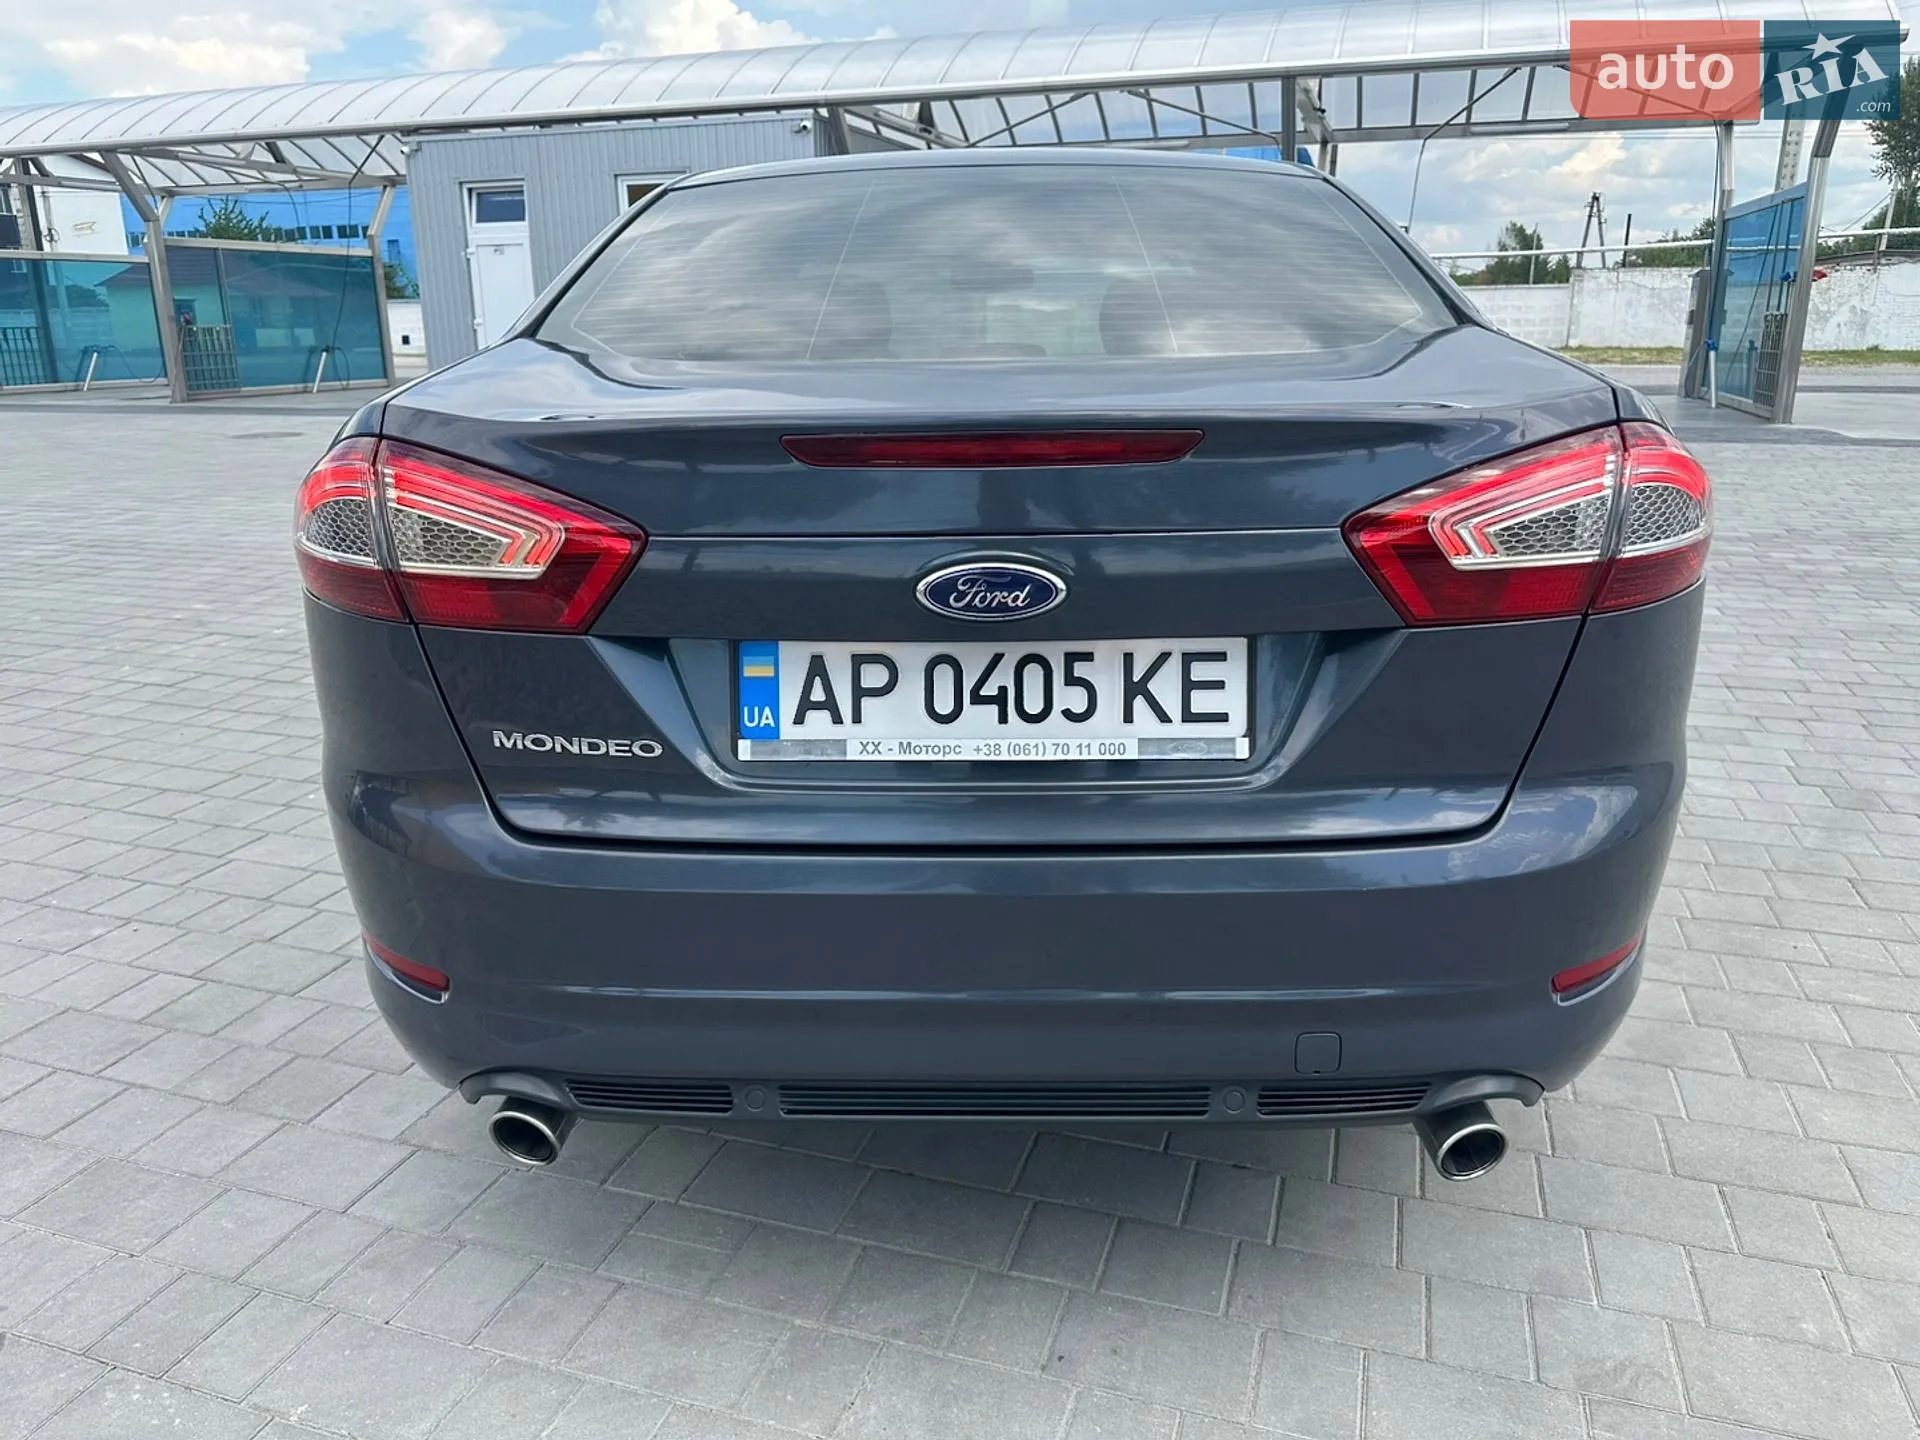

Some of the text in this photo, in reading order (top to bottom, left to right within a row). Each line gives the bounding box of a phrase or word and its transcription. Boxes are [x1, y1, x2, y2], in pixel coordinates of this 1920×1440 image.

[950, 575, 1032, 608] Ford
[792, 651, 1229, 725] AP 0405 KE
[743, 706, 775, 728] UA
[492, 730, 663, 757] MONDEO
[898, 741, 963, 758] Моторс
[973, 742, 1001, 756] +38
[1007, 742, 1047, 758] (061)
[1052, 742, 1071, 756] 70
[1076, 742, 1092, 756] 11
[1098, 742, 1127, 756] 000
